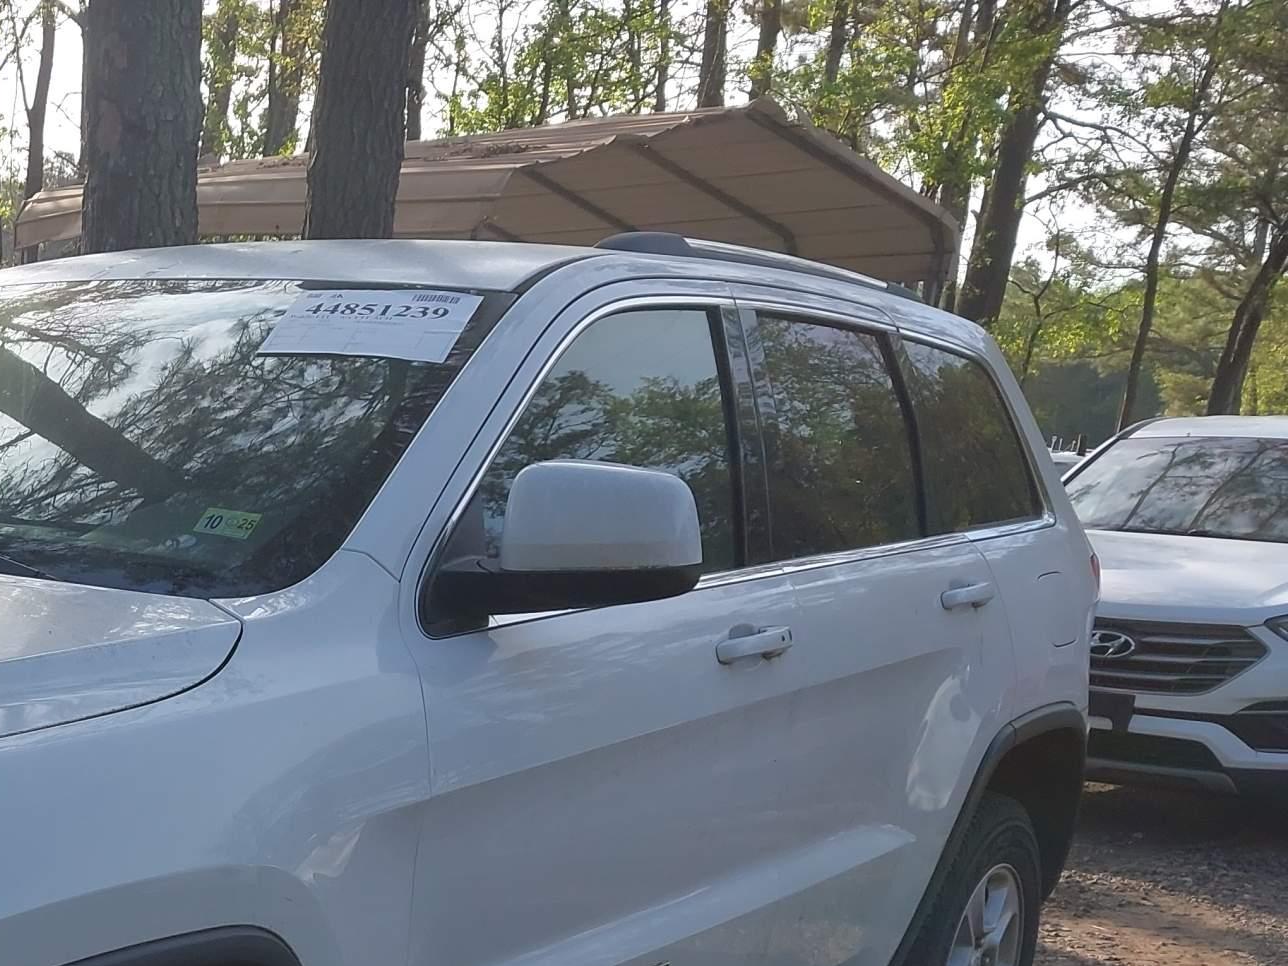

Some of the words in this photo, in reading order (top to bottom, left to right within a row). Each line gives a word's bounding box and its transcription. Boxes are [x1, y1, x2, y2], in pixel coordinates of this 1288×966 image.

[305, 302, 450, 320] 44851239
[203, 514, 224, 530] 10
[237, 518, 256, 530] 25
